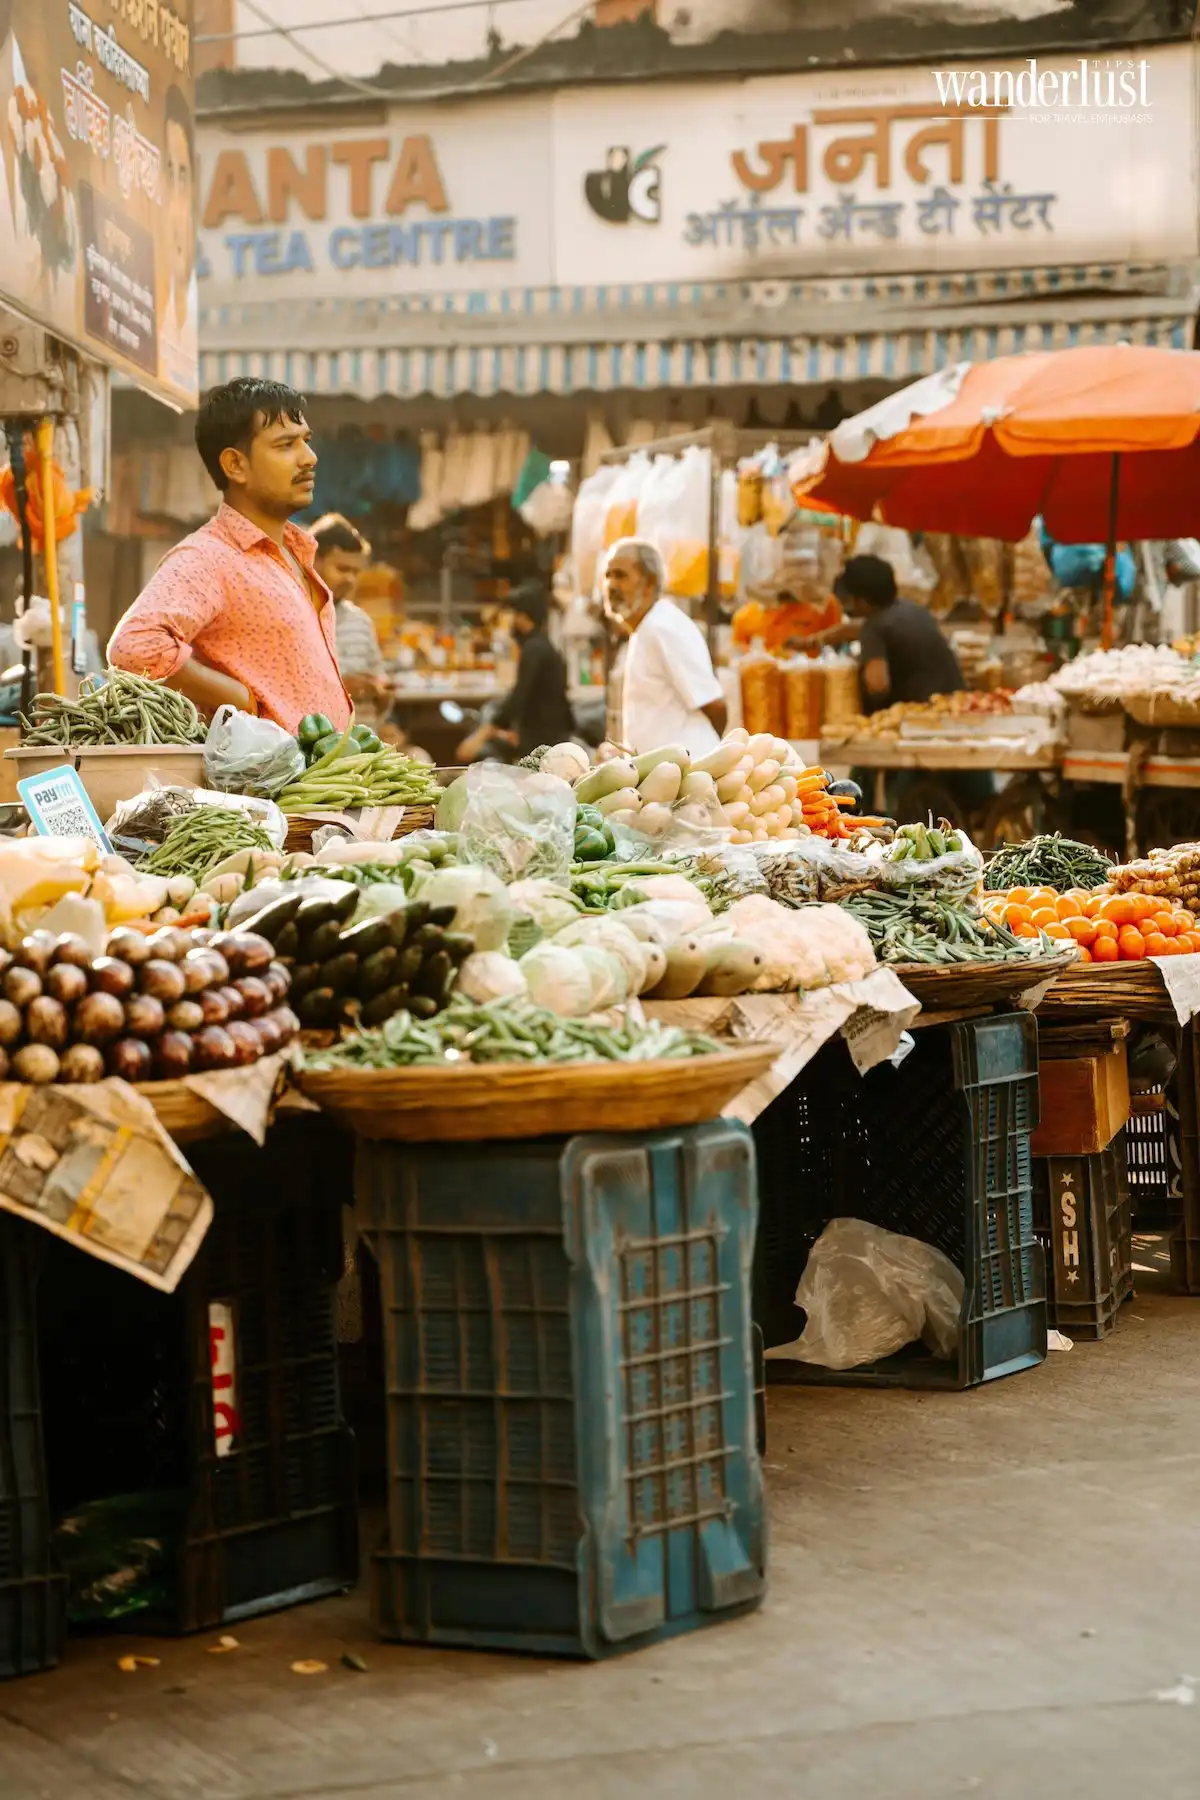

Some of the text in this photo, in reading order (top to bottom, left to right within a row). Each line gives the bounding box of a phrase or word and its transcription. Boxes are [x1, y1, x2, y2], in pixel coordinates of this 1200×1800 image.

[200, 134, 450, 228] ANTA
[731, 97, 1011, 193] जनता
[224, 230, 314, 278] TEA
[328, 214, 518, 271] CENTRE
[916, 187, 960, 236] टी
[1060, 1191, 1080, 1267] SH
